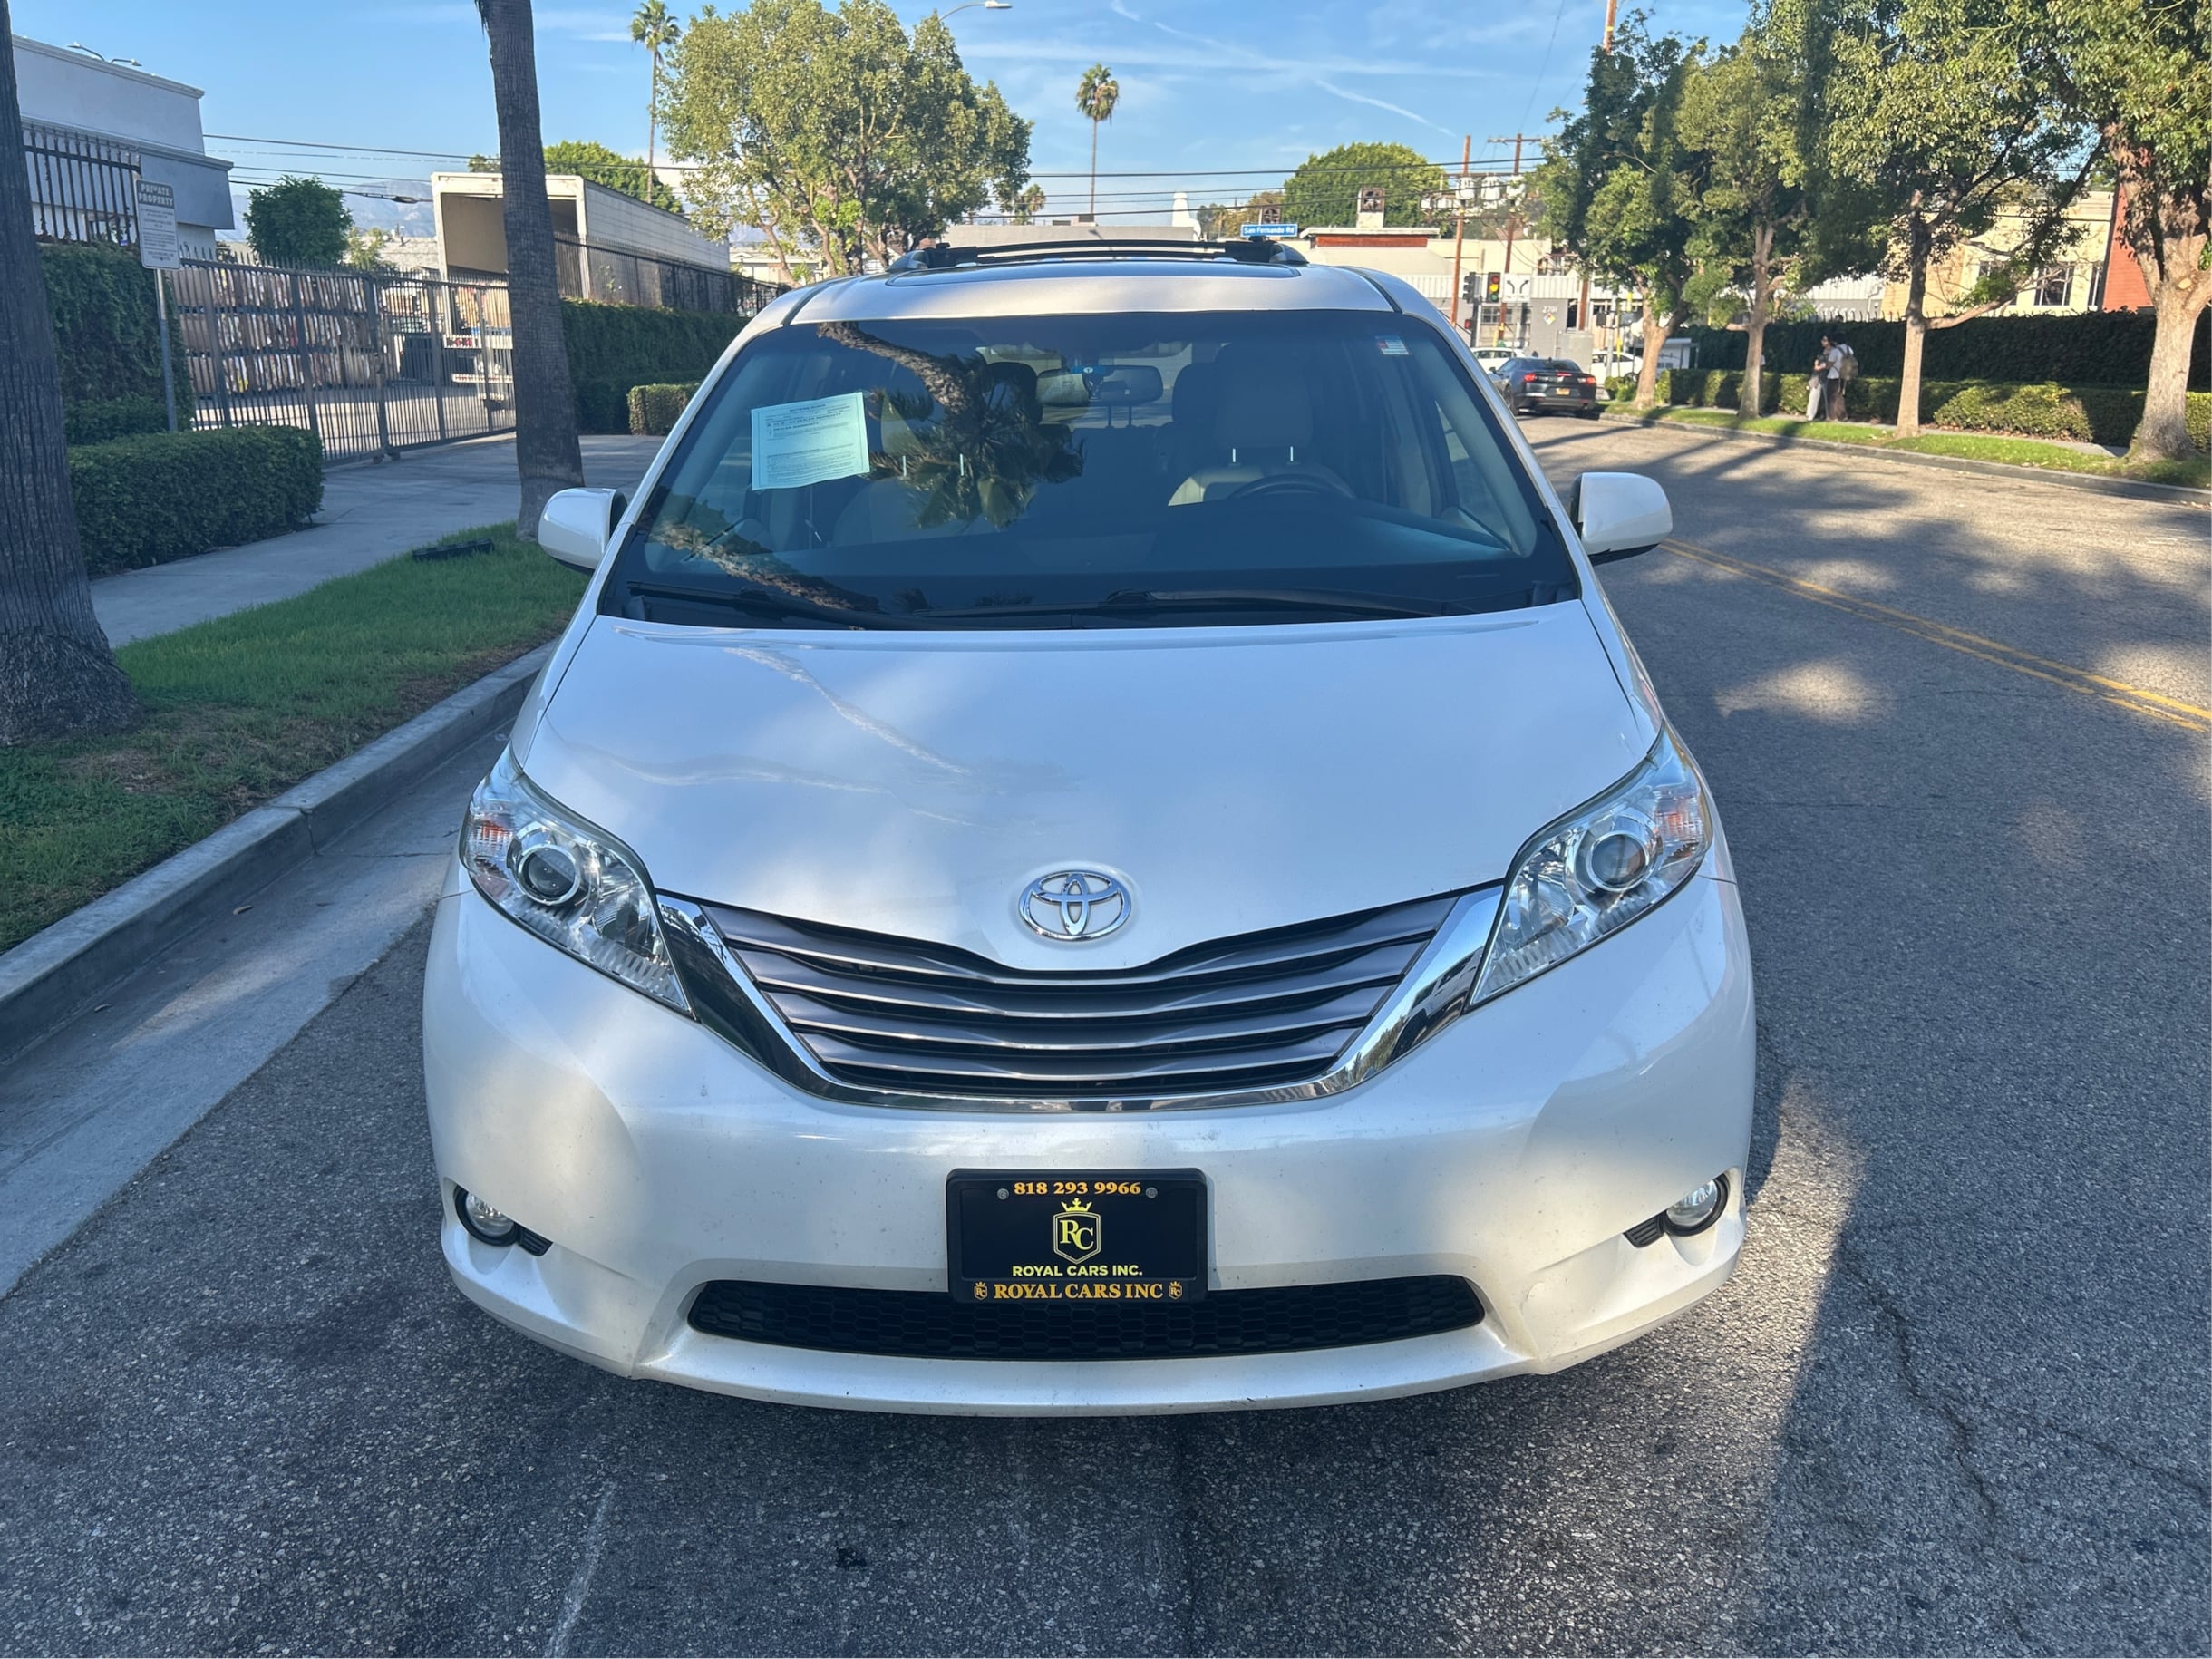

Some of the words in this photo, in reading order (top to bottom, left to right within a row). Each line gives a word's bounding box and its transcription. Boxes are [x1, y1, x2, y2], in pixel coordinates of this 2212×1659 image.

[141, 183, 170, 196] PRIVATE
[138, 192, 173, 207] PROPERTY
[1285, 226, 1295, 234] Rd
[1014, 1181, 1048, 1195] 818
[1053, 1181, 1088, 1195] 293
[1093, 1181, 1141, 1195] 9966
[1059, 1219, 1094, 1250] RC
[1012, 1266, 1063, 1276] ROYAL
[1066, 1265, 1108, 1276] CARS
[1112, 1265, 1143, 1276] INC.
[994, 1284, 1062, 1299] ROYAL
[1064, 1283, 1121, 1299] CARS
[1124, 1284, 1164, 1299] INC
